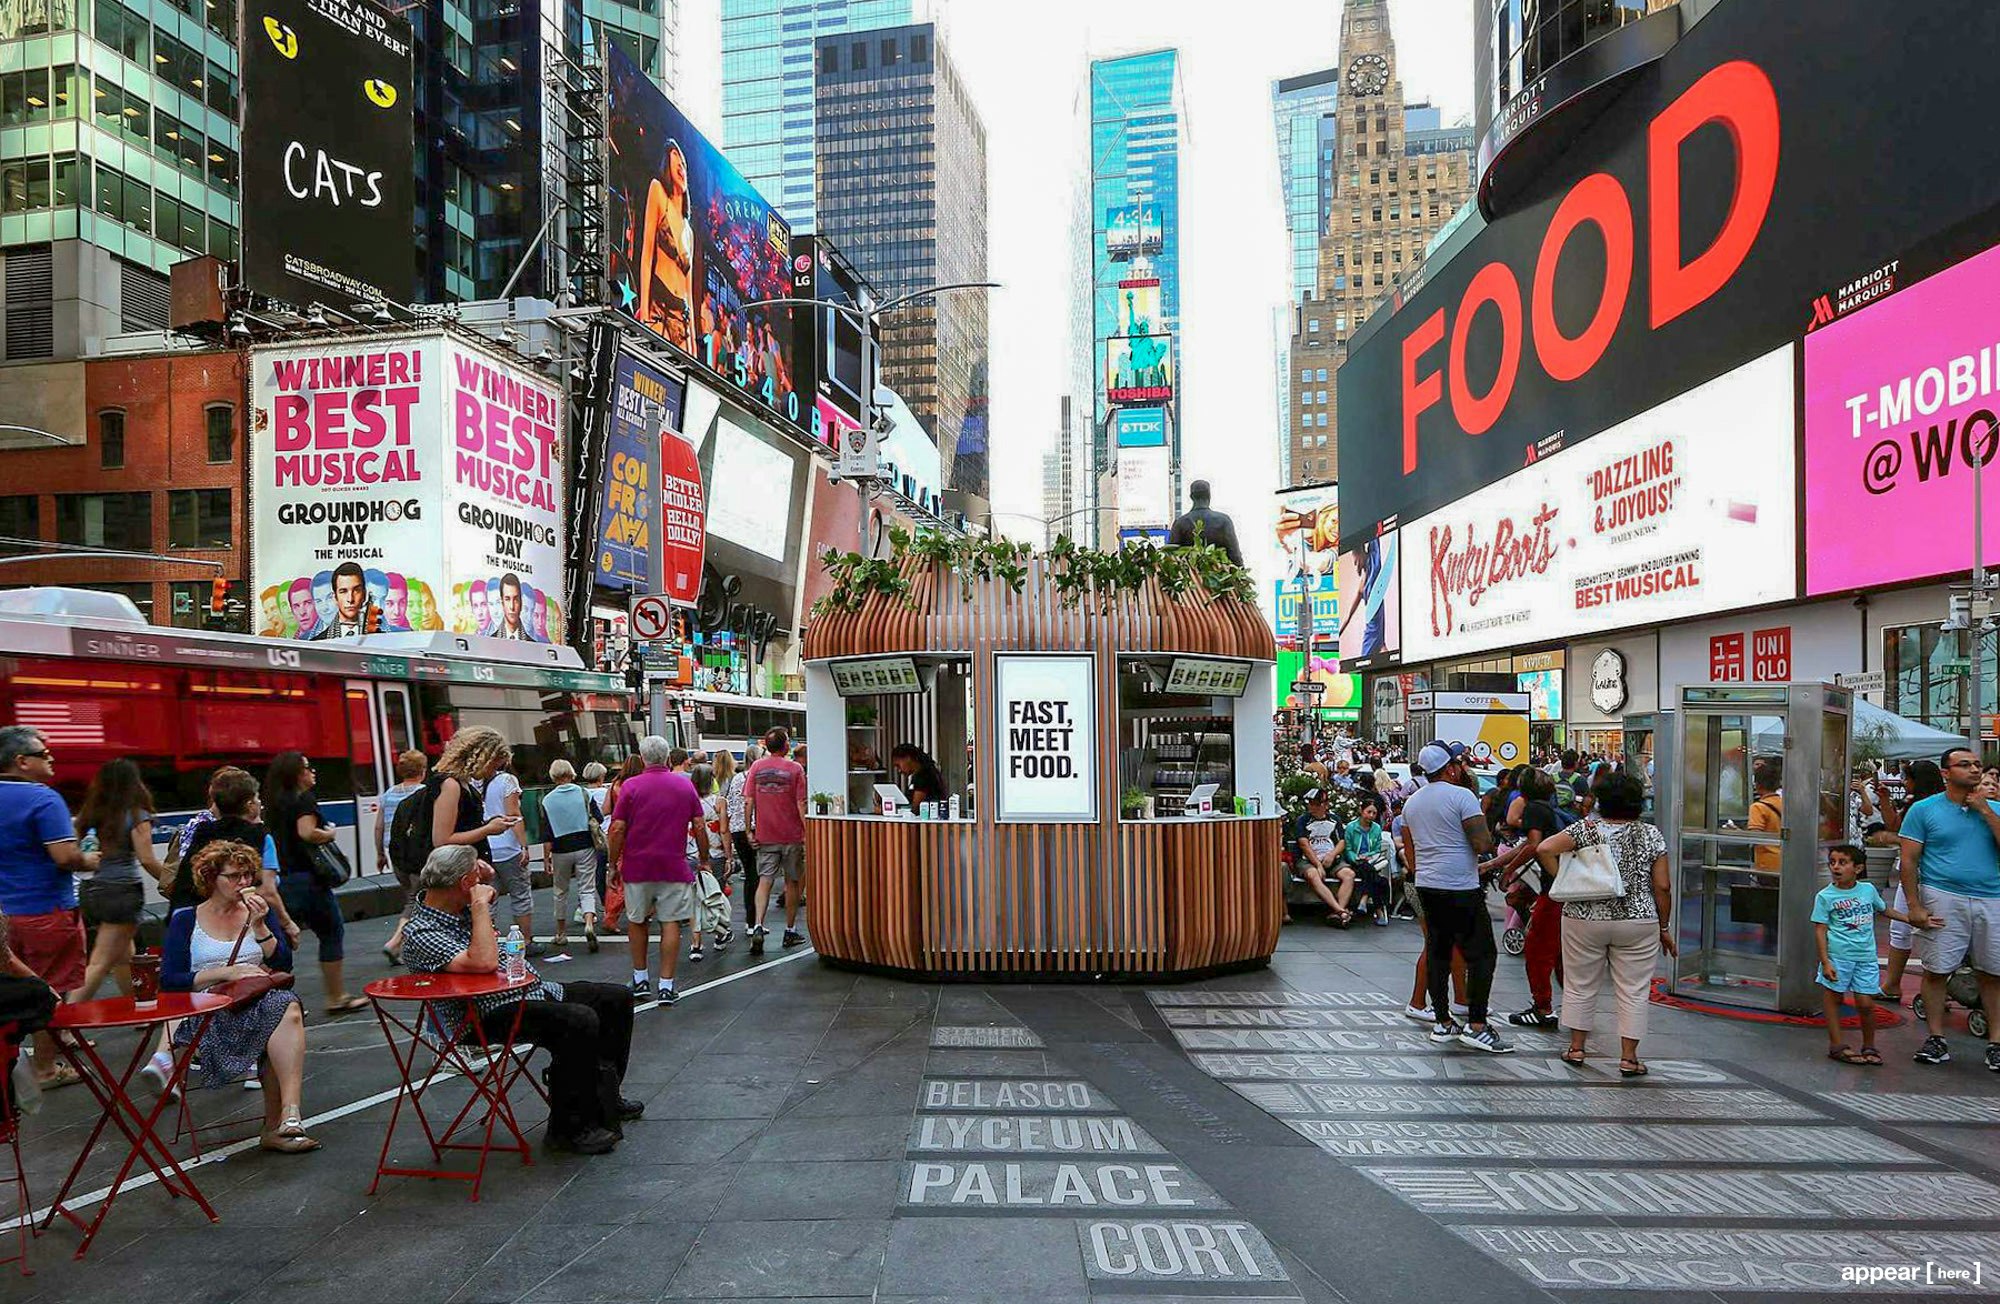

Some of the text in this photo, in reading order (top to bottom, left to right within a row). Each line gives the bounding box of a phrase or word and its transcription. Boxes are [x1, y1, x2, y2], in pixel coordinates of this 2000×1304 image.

[319, 1, 362, 31] THAN
[354, 5, 387, 30] AND
[284, 140, 383, 207] CATS
[284, 253, 383, 300] CATSBROADWAY.COM
[1402, 60, 1781, 476] FOOD
[1838, 260, 1899, 299] MARRIOTT
[795, 276, 810, 287] LG
[1118, 280, 1159, 289] TOSHIBA
[1838, 279, 1892, 313] MARQUIS
[273, 350, 422, 391] WINNER!
[455, 353, 557, 425] WINNER!
[618, 384, 641, 413] BEST
[634, 370, 667, 405] WINNER!
[1110, 387, 1171, 399] TOSHIBA
[275, 388, 420, 451] BEST
[1131, 422, 1161, 432] TDK
[455, 390, 556, 479] BEST
[275, 450, 421, 487] MUSICAL
[457, 453, 556, 513] MUSICAL
[665, 474, 700, 497] BETTE
[278, 500, 421, 524] GROUNDHOG
[663, 489, 703, 513] MIDLER
[458, 502, 556, 547] GROUNDHOG
[1594, 505, 1606, 534] &
[328, 524, 369, 546] DAY
[495, 533, 523, 559] DAY
[667, 525, 701, 546] DOLLY!
[314, 548, 383, 559] THE MUSICAL
[486, 555, 533, 574] THE MUSICAL
[1674, 549, 1699, 564] WINNING
[1429, 502, 1560, 637] Kinky Boots
[1575, 563, 1700, 610] BEST MUSICAL
[87, 640, 161, 658] SINNER
[1714, 640, 1738, 660] ユニ
[1757, 635, 1785, 656] UNI
[360, 661, 405, 675] SINNER
[1757, 659, 1787, 682] QLO
[1009, 701, 1073, 727] FAST,
[1010, 729, 1073, 752] MEET
[1010, 755, 1078, 779] FOOD.
[1837, 903, 1872, 920] SUPER
[1156, 992, 1400, 1005] NEDERLANDER
[1180, 1030, 1382, 1050] LYRIC
[1198, 1055, 1358, 1066] HELEN
[1208, 1066, 1372, 1078] HAYES
[926, 1081, 1092, 1109] BELASCO
[1326, 1100, 1494, 1113] BOOTH
[919, 1117, 1138, 1151] LYCEUM
[1301, 1122, 1513, 1138] MUSIC BOX
[1323, 1140, 1537, 1156] MARQUIS
[908, 1163, 1195, 1207] PALACE
[1472, 1171, 1832, 1214] FONTANNE
[1089, 1223, 1262, 1276] CORT
[1475, 1229, 1890, 1256] ETHEL BARRYMORE
